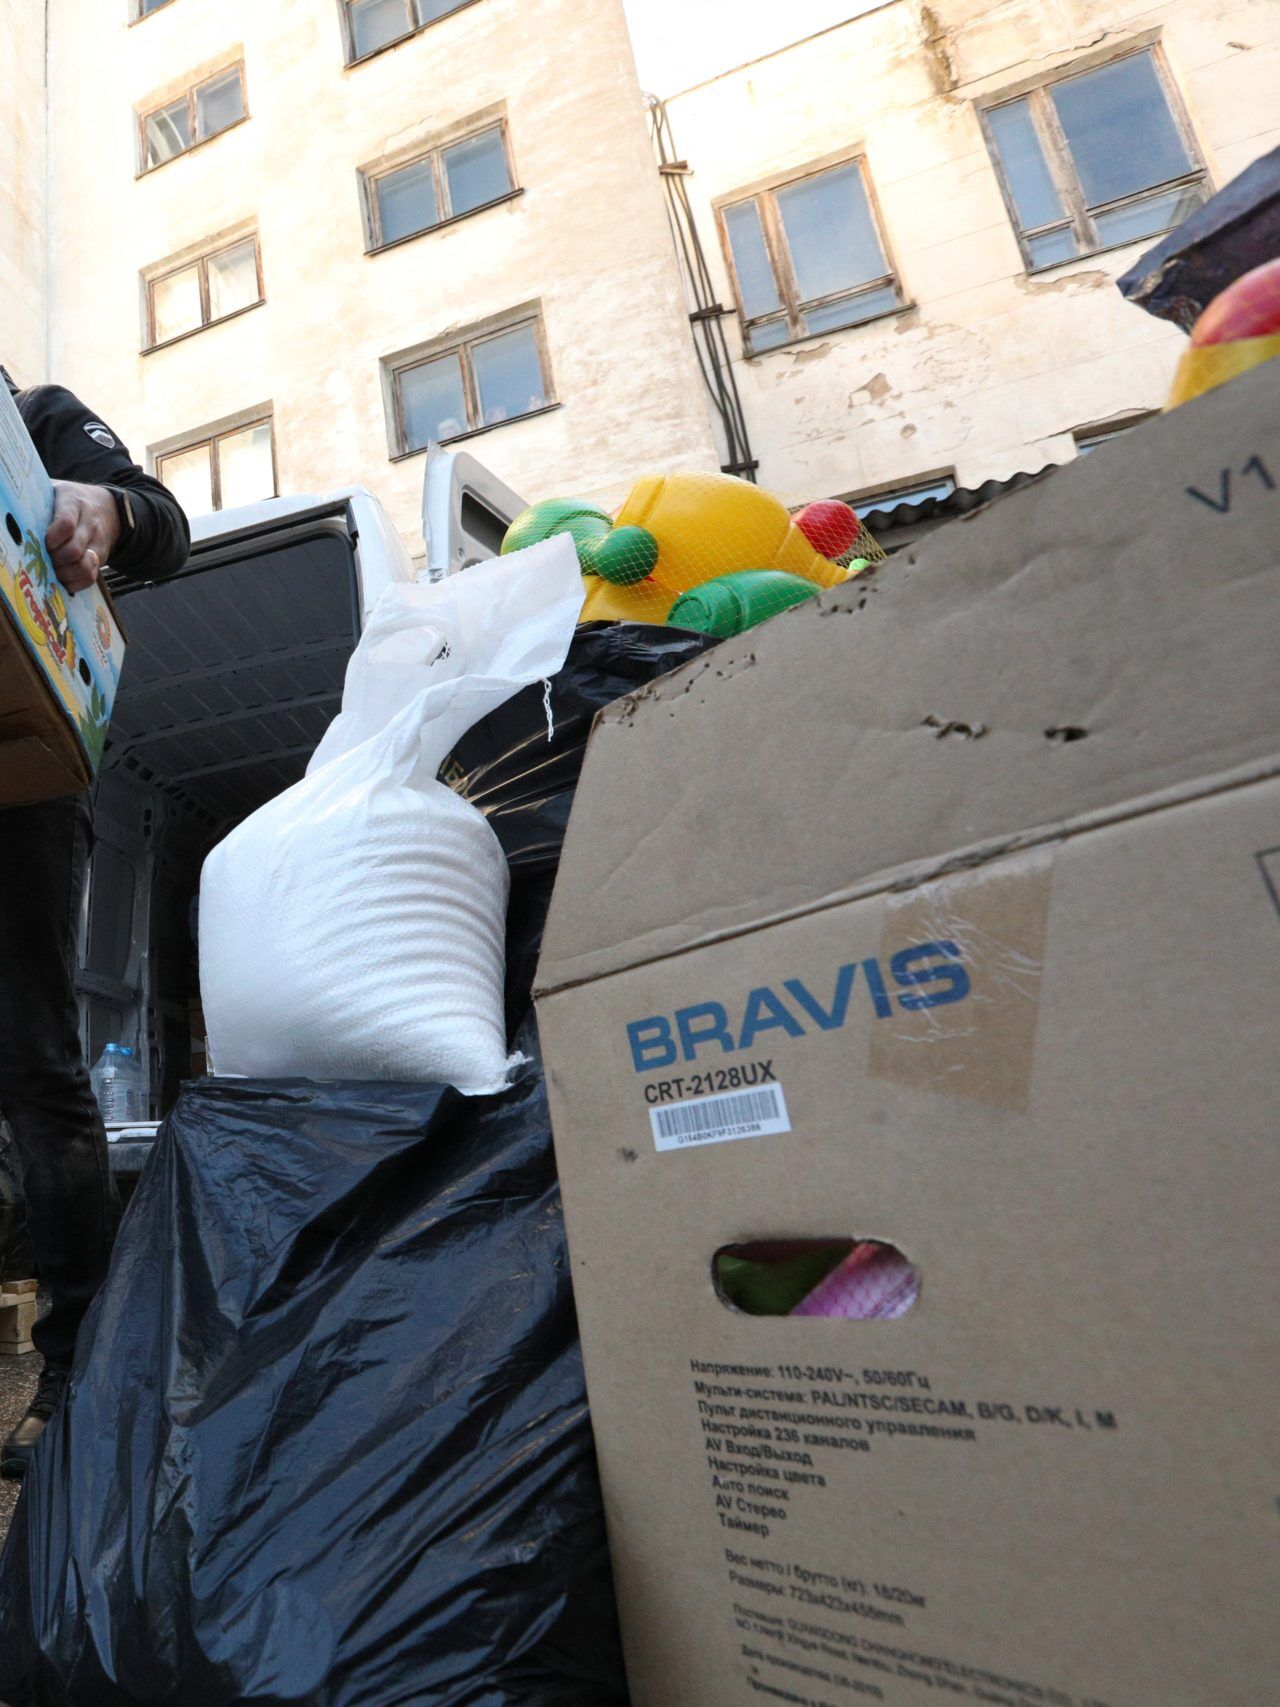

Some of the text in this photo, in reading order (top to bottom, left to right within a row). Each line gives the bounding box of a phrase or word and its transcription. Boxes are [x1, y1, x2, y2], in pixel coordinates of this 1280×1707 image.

[19, 568, 67, 665] Tropical
[626, 939, 972, 1073] BRAVIS
[644, 1060, 777, 1104] CRT-2128UX
[690, 1359, 773, 1379] Напряжение:
[862, 1369, 931, 1390] 50/60Гц
[694, 1381, 806, 1404] Мульти-система:
[697, 1400, 736, 1419] Пульт
[739, 1405, 862, 1431] дистанционного
[701, 1418, 771, 1441] Настройка
[803, 1433, 870, 1452] каналов
[725, 1440, 814, 1466] Вход/Выход
[708, 1455, 827, 1488] Настройка цвета
[747, 1481, 790, 1502] поиск
[736, 1497, 787, 1521] Стерео
[718, 1512, 770, 1539] Таймер
